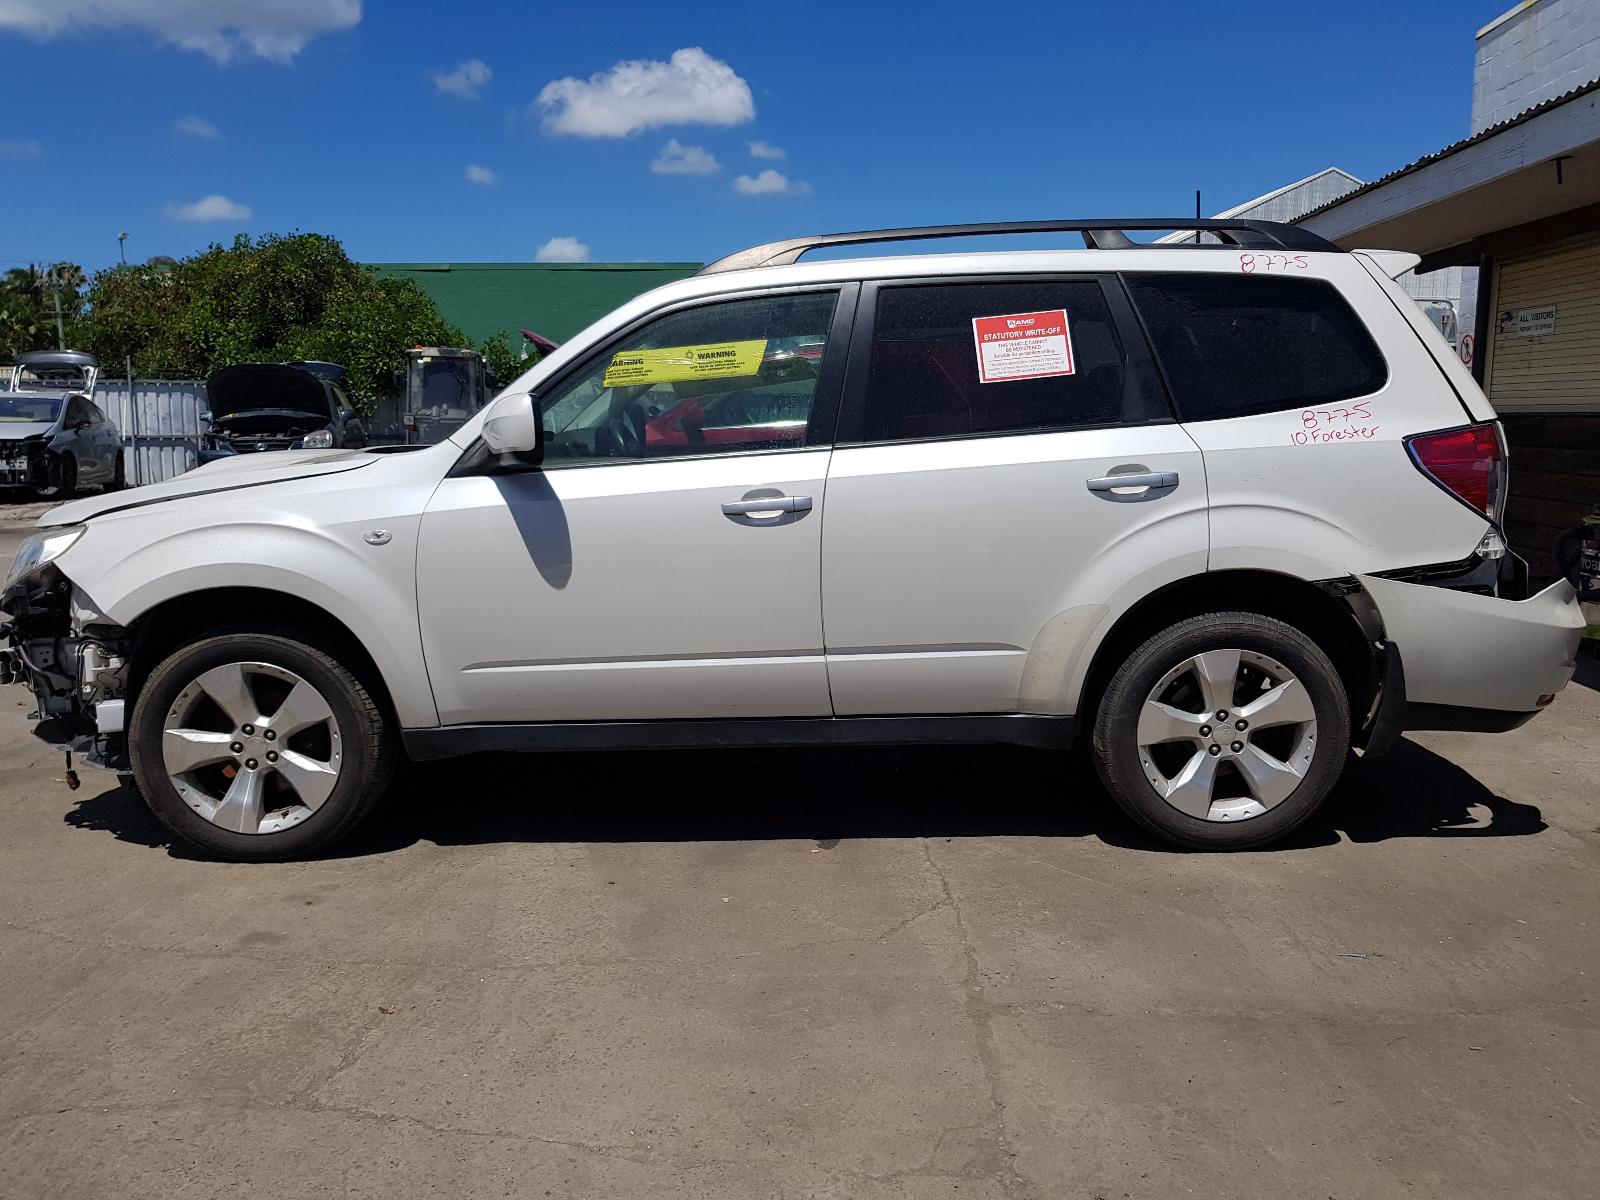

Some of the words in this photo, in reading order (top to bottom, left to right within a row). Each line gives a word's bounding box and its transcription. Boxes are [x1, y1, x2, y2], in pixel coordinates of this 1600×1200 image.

[1240, 254, 1309, 275] 8775
[1520, 314, 1530, 322] ALL
[1531, 311, 1554, 321] VISITORS
[984, 331, 1024, 340] STATUTORY
[1025, 327, 1061, 337] WRITE-OFF
[697, 350, 737, 360] WARNING
[1302, 400, 1372, 429] 8775
[1311, 425, 1380, 443] Forester
